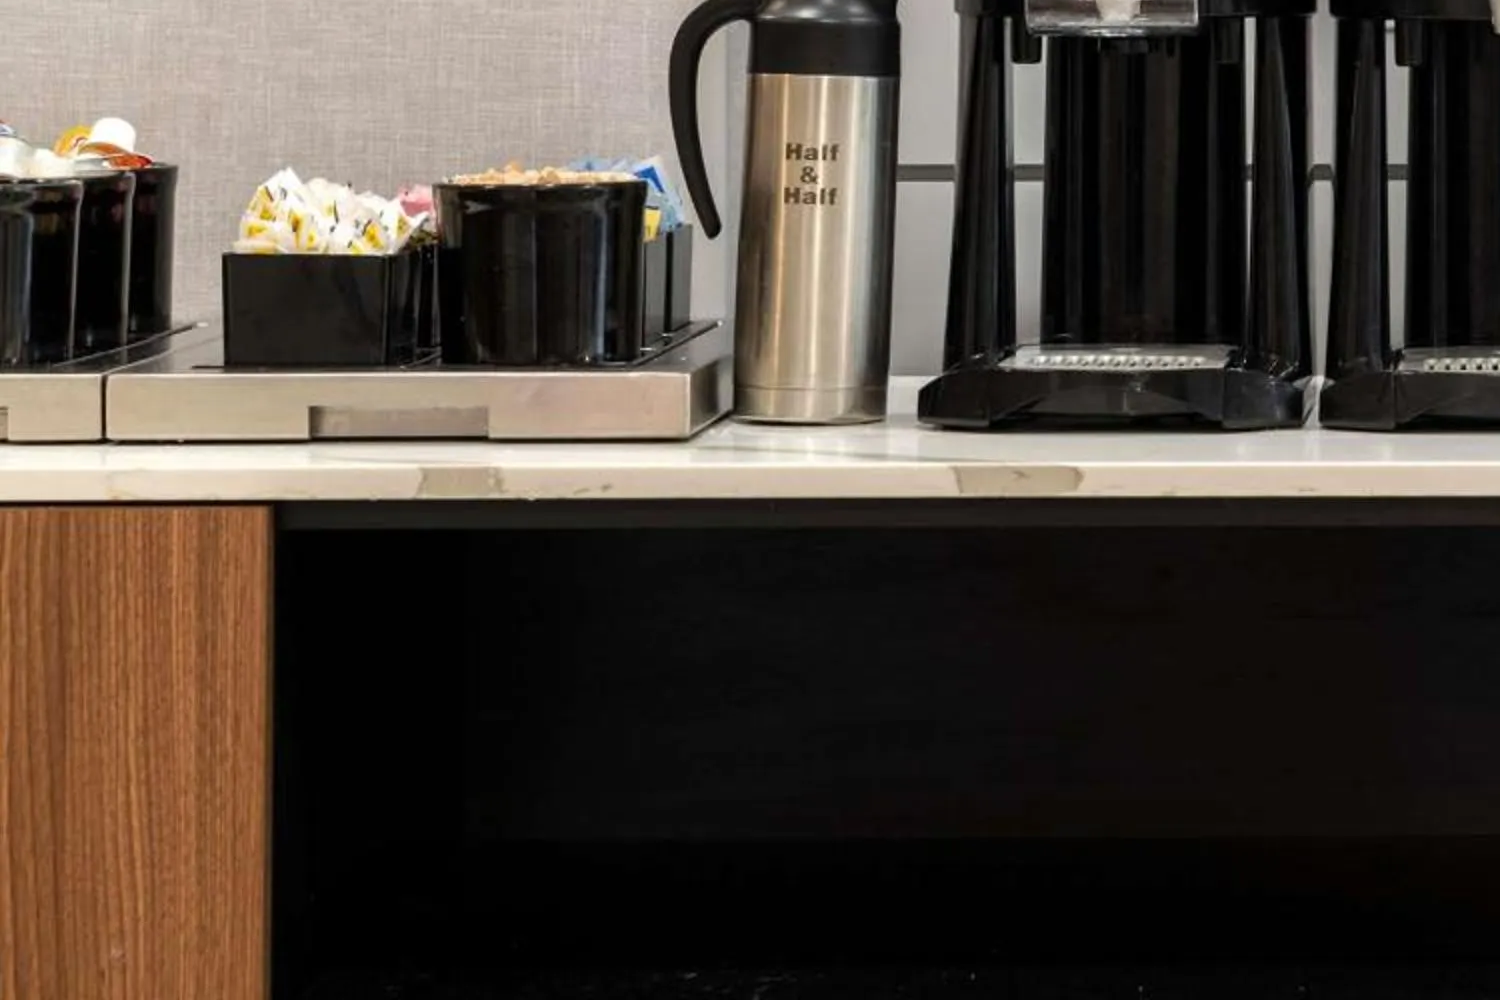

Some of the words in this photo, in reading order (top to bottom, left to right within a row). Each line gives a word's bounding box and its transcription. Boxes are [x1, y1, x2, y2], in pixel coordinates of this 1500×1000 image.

[785, 143, 840, 161] Half
[800, 166, 818, 184] &
[783, 187, 838, 206] Half
